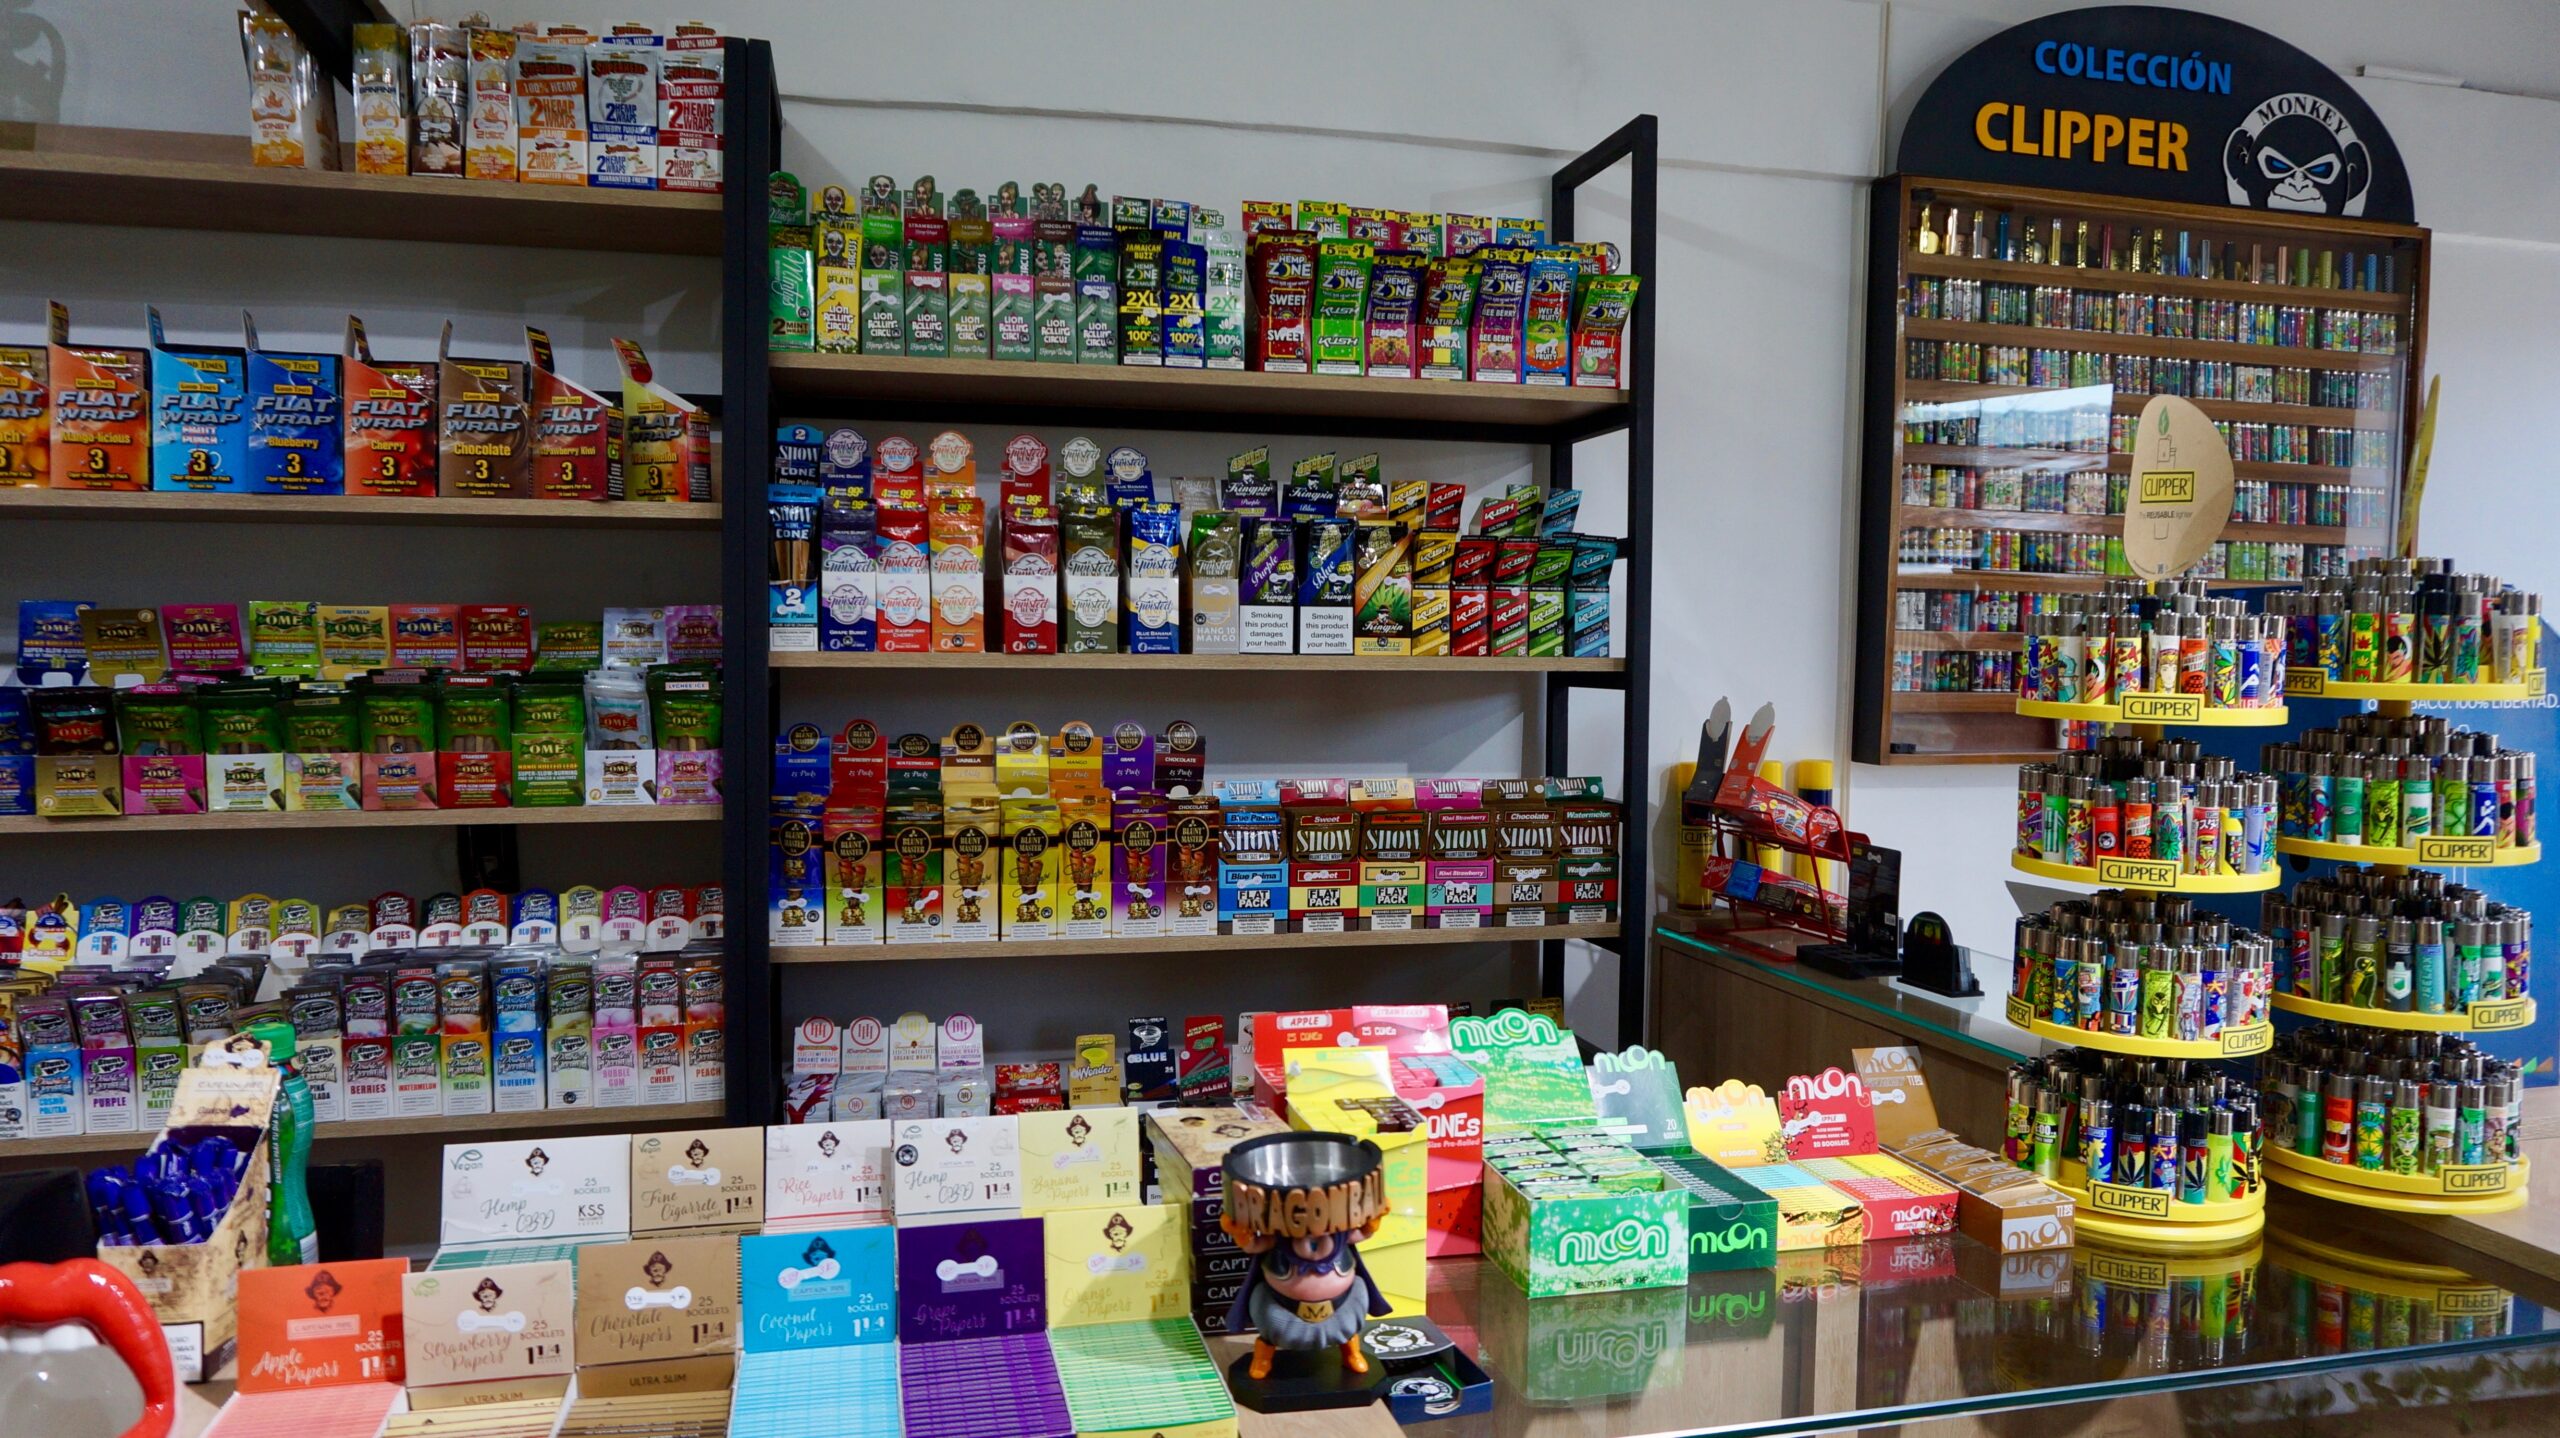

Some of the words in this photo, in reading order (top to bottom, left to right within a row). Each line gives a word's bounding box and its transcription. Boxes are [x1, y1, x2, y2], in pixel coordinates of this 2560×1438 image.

[2034, 40, 2232, 94] COLECCIÓN
[683, 101, 714, 117] HEMP
[2259, 96, 2348, 134] MONKEY
[1974, 101, 2189, 171] CLIPPER
[1269, 294, 1306, 306] SWEET
[57, 391, 139, 406] FLAT
[256, 397, 332, 412] FLAT
[59, 409, 138, 420] WRAP
[352, 401, 426, 415] FLAT
[447, 404, 519, 419] FLAT
[257, 414, 333, 425] WRAP
[353, 419, 425, 429] WRAP
[447, 422, 519, 434] WRAP
[371, 440, 405, 452] Cherry
[454, 443, 511, 456] Chocolate
[90, 449, 104, 469] 3
[382, 457, 395, 476] 3
[475, 460, 488, 479] 3
[2145, 478, 2188, 496] CLIPPER
[1251, 612, 1283, 620] Smoking
[1311, 613, 1343, 621] Smoking
[1250, 630, 1283, 638] damages
[1320, 623, 1349, 631] product
[1246, 640, 1261, 648] your
[1264, 639, 1287, 647] health
[2286, 674, 2318, 690] IPPER
[2130, 701, 2193, 717] CLIPPER
[2427, 843, 2488, 858] CLIPPER
[2106, 864, 2168, 882] CLIPPER
[1239, 890, 1268, 899] FLAT
[1309, 888, 1338, 897] FLAT
[1377, 887, 1406, 896] FLAT
[1239, 899, 1268, 908] PACK
[1309, 897, 1338, 906] PACK
[1377, 895, 1406, 904] PACK
[1290, 1017, 1319, 1025] APPLE
[2478, 1007, 2521, 1025] CLIPPER
[1453, 1013, 1557, 1047] moon
[2228, 1030, 2266, 1050] CLIPPER
[696, 1067, 721, 1077] PEACH
[1788, 1069, 1862, 1100] moon
[93, 1097, 127, 1108] PURPLE
[1427, 1112, 1480, 1139] ONEs
[451, 1159, 483, 1171] Vegan
[989, 1163, 1001, 1171] 25
[584, 1178, 598, 1186] 25
[731, 1176, 743, 1184] 25
[778, 1177, 811, 1195] Rice
[905, 1171, 948, 1191] Hemp
[2451, 1172, 2501, 1188] CLIPPER
[574, 1186, 610, 1195] BOOKLETS
[721, 1183, 757, 1192] BOOKLETS
[2099, 1190, 2161, 1211] CLIPPER
[480, 1199, 527, 1219] Hemp
[578, 1204, 605, 1218] KSS
[1559, 1220, 1668, 1264] moon
[1690, 1222, 1767, 1254] moon
[698, 1296, 713, 1307] 25
[858, 1293, 873, 1304] 25
[686, 1306, 729, 1318] BOOKLETS
[847, 1303, 888, 1314] BOOKLETS
[532, 1321, 548, 1330] 25
[590, 1308, 663, 1337] Chocolate
[759, 1308, 817, 1334] Coconut
[368, 1331, 384, 1341] 25
[519, 1329, 565, 1340] BOOKLETS
[610, 1326, 672, 1350] Papers
[783, 1322, 833, 1345] Papers
[422, 1333, 512, 1361] Strawberry
[251, 1349, 304, 1377] Apple
[443, 1352, 505, 1373] Papers
[275, 1363, 340, 1385] Papers
[630, 1375, 659, 1387] ULTRA
[663, 1374, 687, 1383] SLIM
[464, 1394, 495, 1405] ULTRA
[499, 1391, 523, 1401] SLIM
